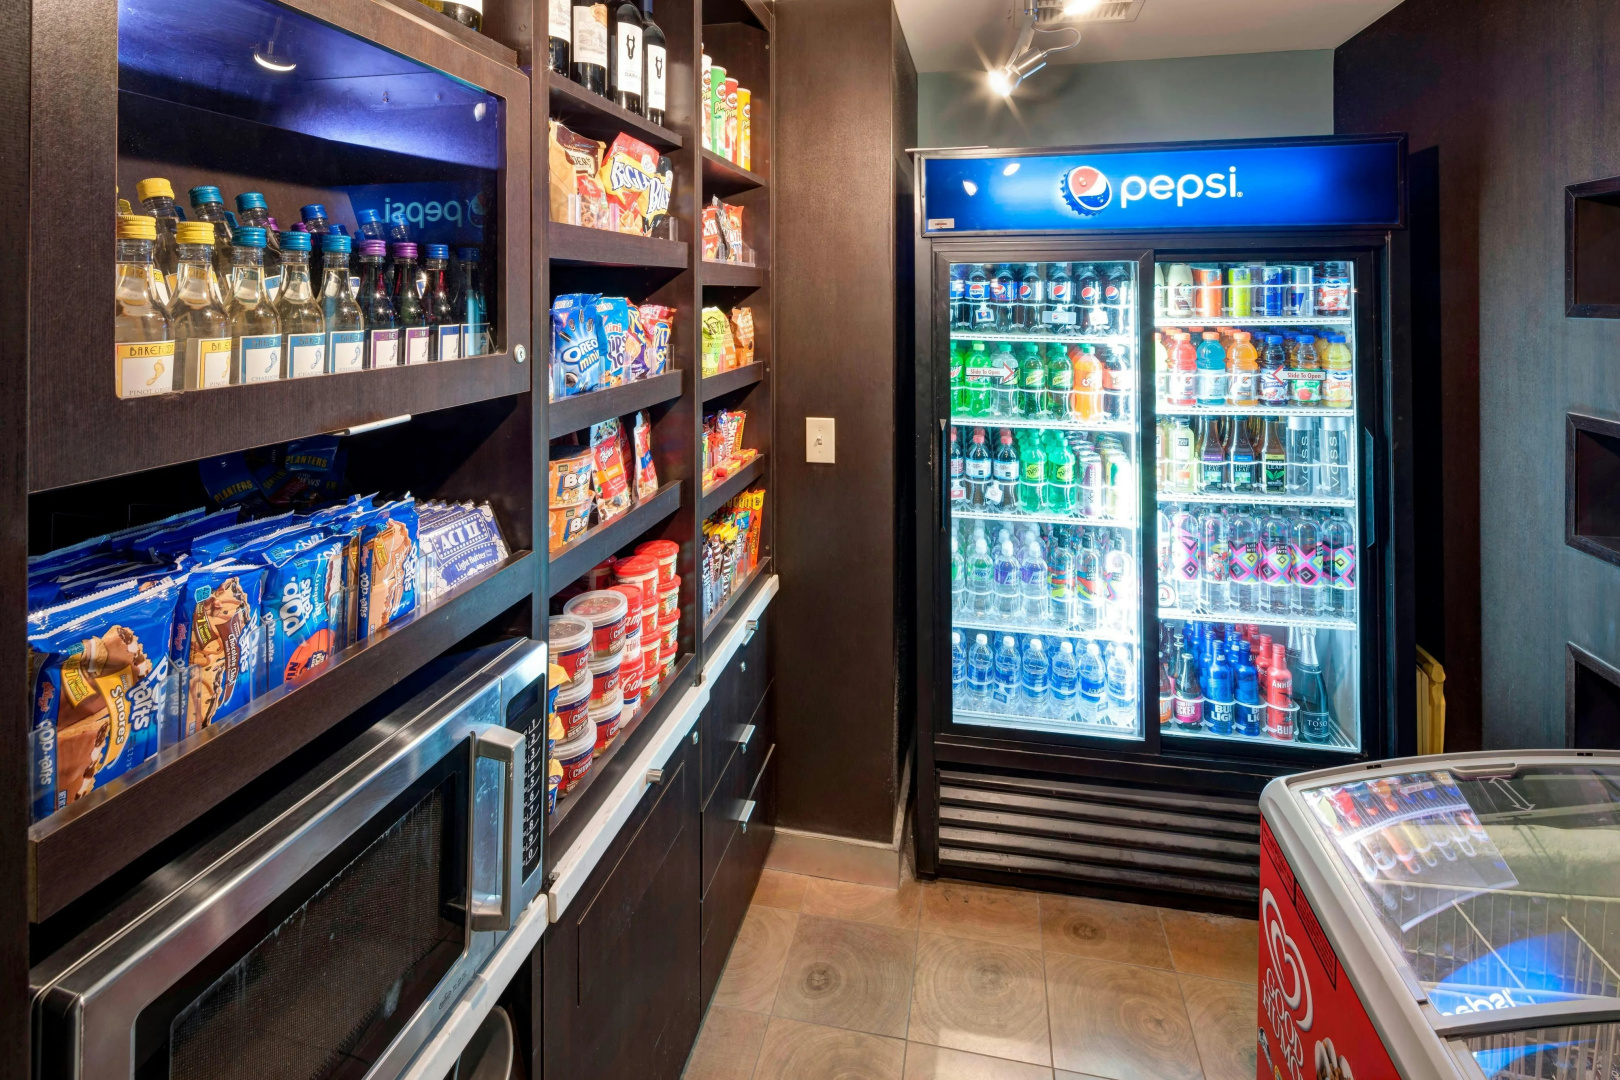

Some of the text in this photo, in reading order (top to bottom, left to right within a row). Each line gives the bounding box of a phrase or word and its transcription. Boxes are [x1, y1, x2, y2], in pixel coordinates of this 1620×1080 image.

[1120, 166, 1237, 208] pepsi
[562, 338, 599, 363] OREO
[1307, 372, 1322, 380] Open
[285, 455, 328, 469] PLANTERS
[213, 480, 254, 504] PLANTERS
[440, 520, 482, 552] ACT II
[454, 551, 487, 573] Light Butter
[227, 632, 238, 667] Chocolate
[128, 682, 154, 731] tarts
[110, 684, 128, 745] S'mores
[531, 719, 537, 729] 1
[1307, 719, 1328, 728] TOSO
[530, 733, 537, 743] 2
[530, 747, 536, 757] 3
[530, 761, 536, 772] 4
[529, 776, 536, 786] 5
[529, 790, 535, 801] 6
[529, 805, 535, 815] 7
[528, 819, 535, 830] 8
[528, 833, 534, 844] 9
[528, 848, 534, 859] 0
